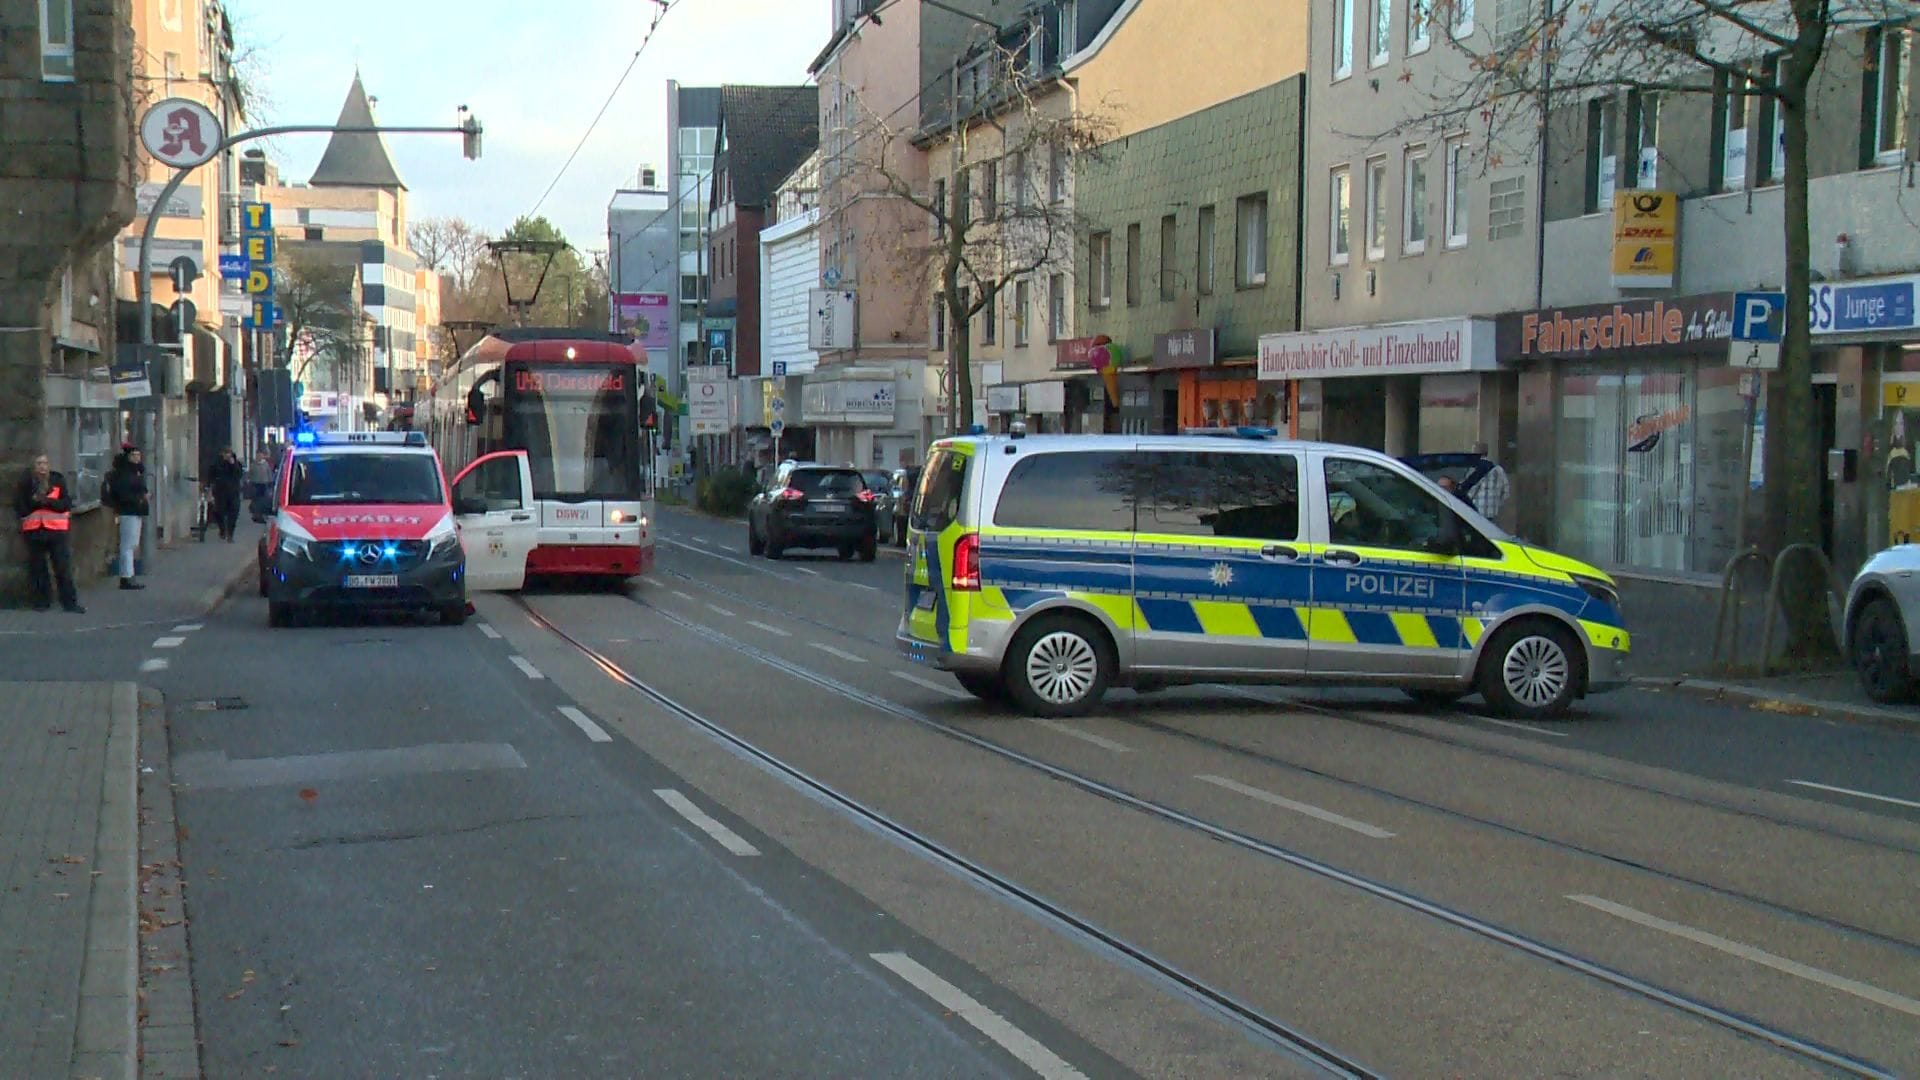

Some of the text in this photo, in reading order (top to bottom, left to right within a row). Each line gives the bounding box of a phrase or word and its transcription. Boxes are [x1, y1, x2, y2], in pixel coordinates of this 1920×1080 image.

[1743, 298, 1772, 339] P
[1844, 293, 1886, 325] Junge
[1520, 301, 1684, 355] Fahrschule
[1262, 342, 1328, 373] Handyzubehör
[1362, 337, 1383, 367] und
[1386, 330, 1460, 366] Einzelhandel
[547, 373, 625, 391] Dorstfeld
[312, 514, 422, 527] NOTARZT
[1345, 573, 1435, 599] POLIZEI
